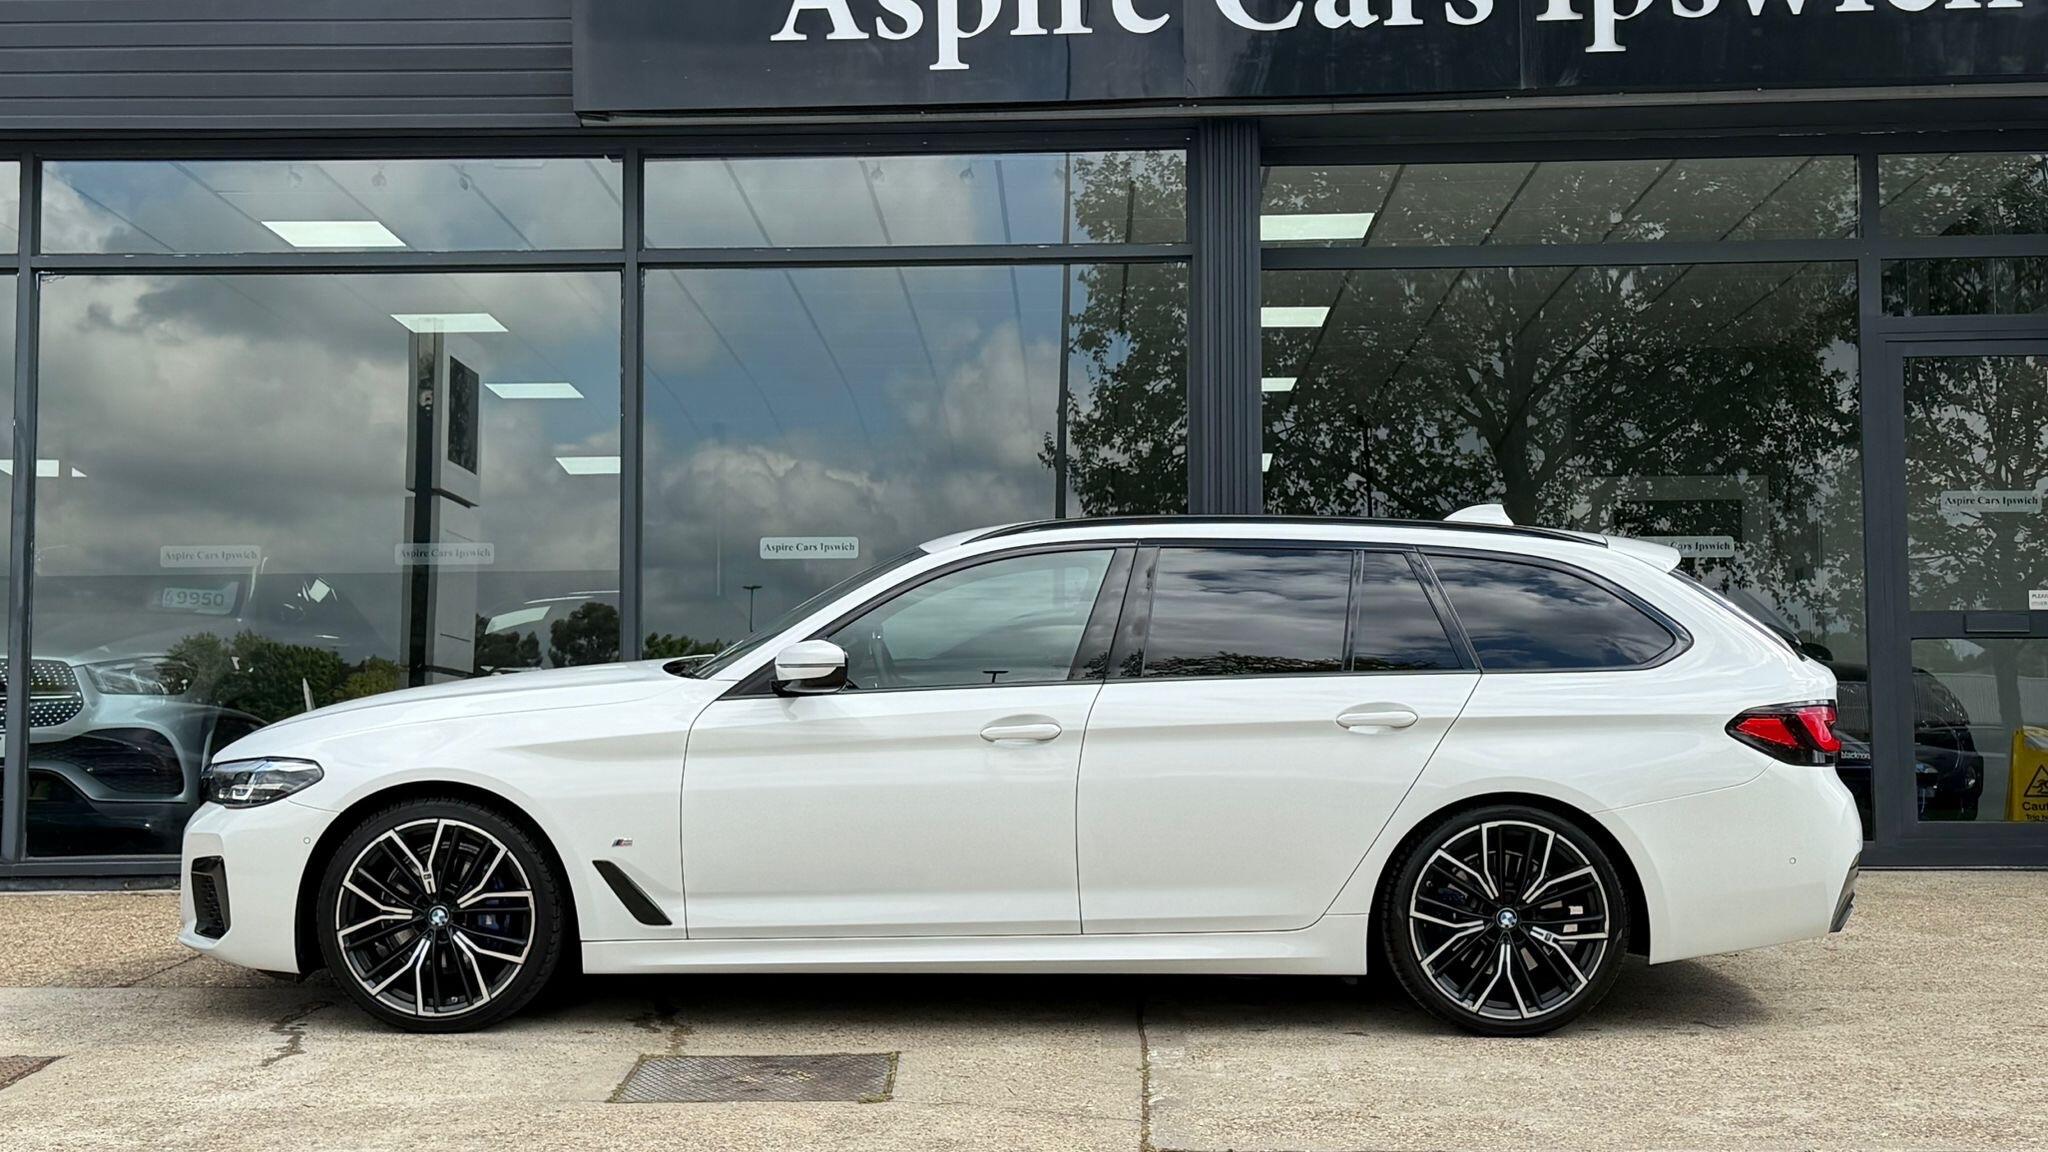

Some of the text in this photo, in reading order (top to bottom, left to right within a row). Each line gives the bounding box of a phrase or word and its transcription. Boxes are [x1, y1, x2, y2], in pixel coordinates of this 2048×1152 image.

[1945, 496, 2038, 507] Aspire Cars Ipswich
[765, 542, 855, 553] Aspire Cars Ipswich
[1695, 541, 1730, 552] Ipswich
[166, 550, 257, 561] Aspire Cars Ipswich
[401, 548, 490, 559] Aspire Cars Ipswich
[2022, 801, 2048, 811] Cau
